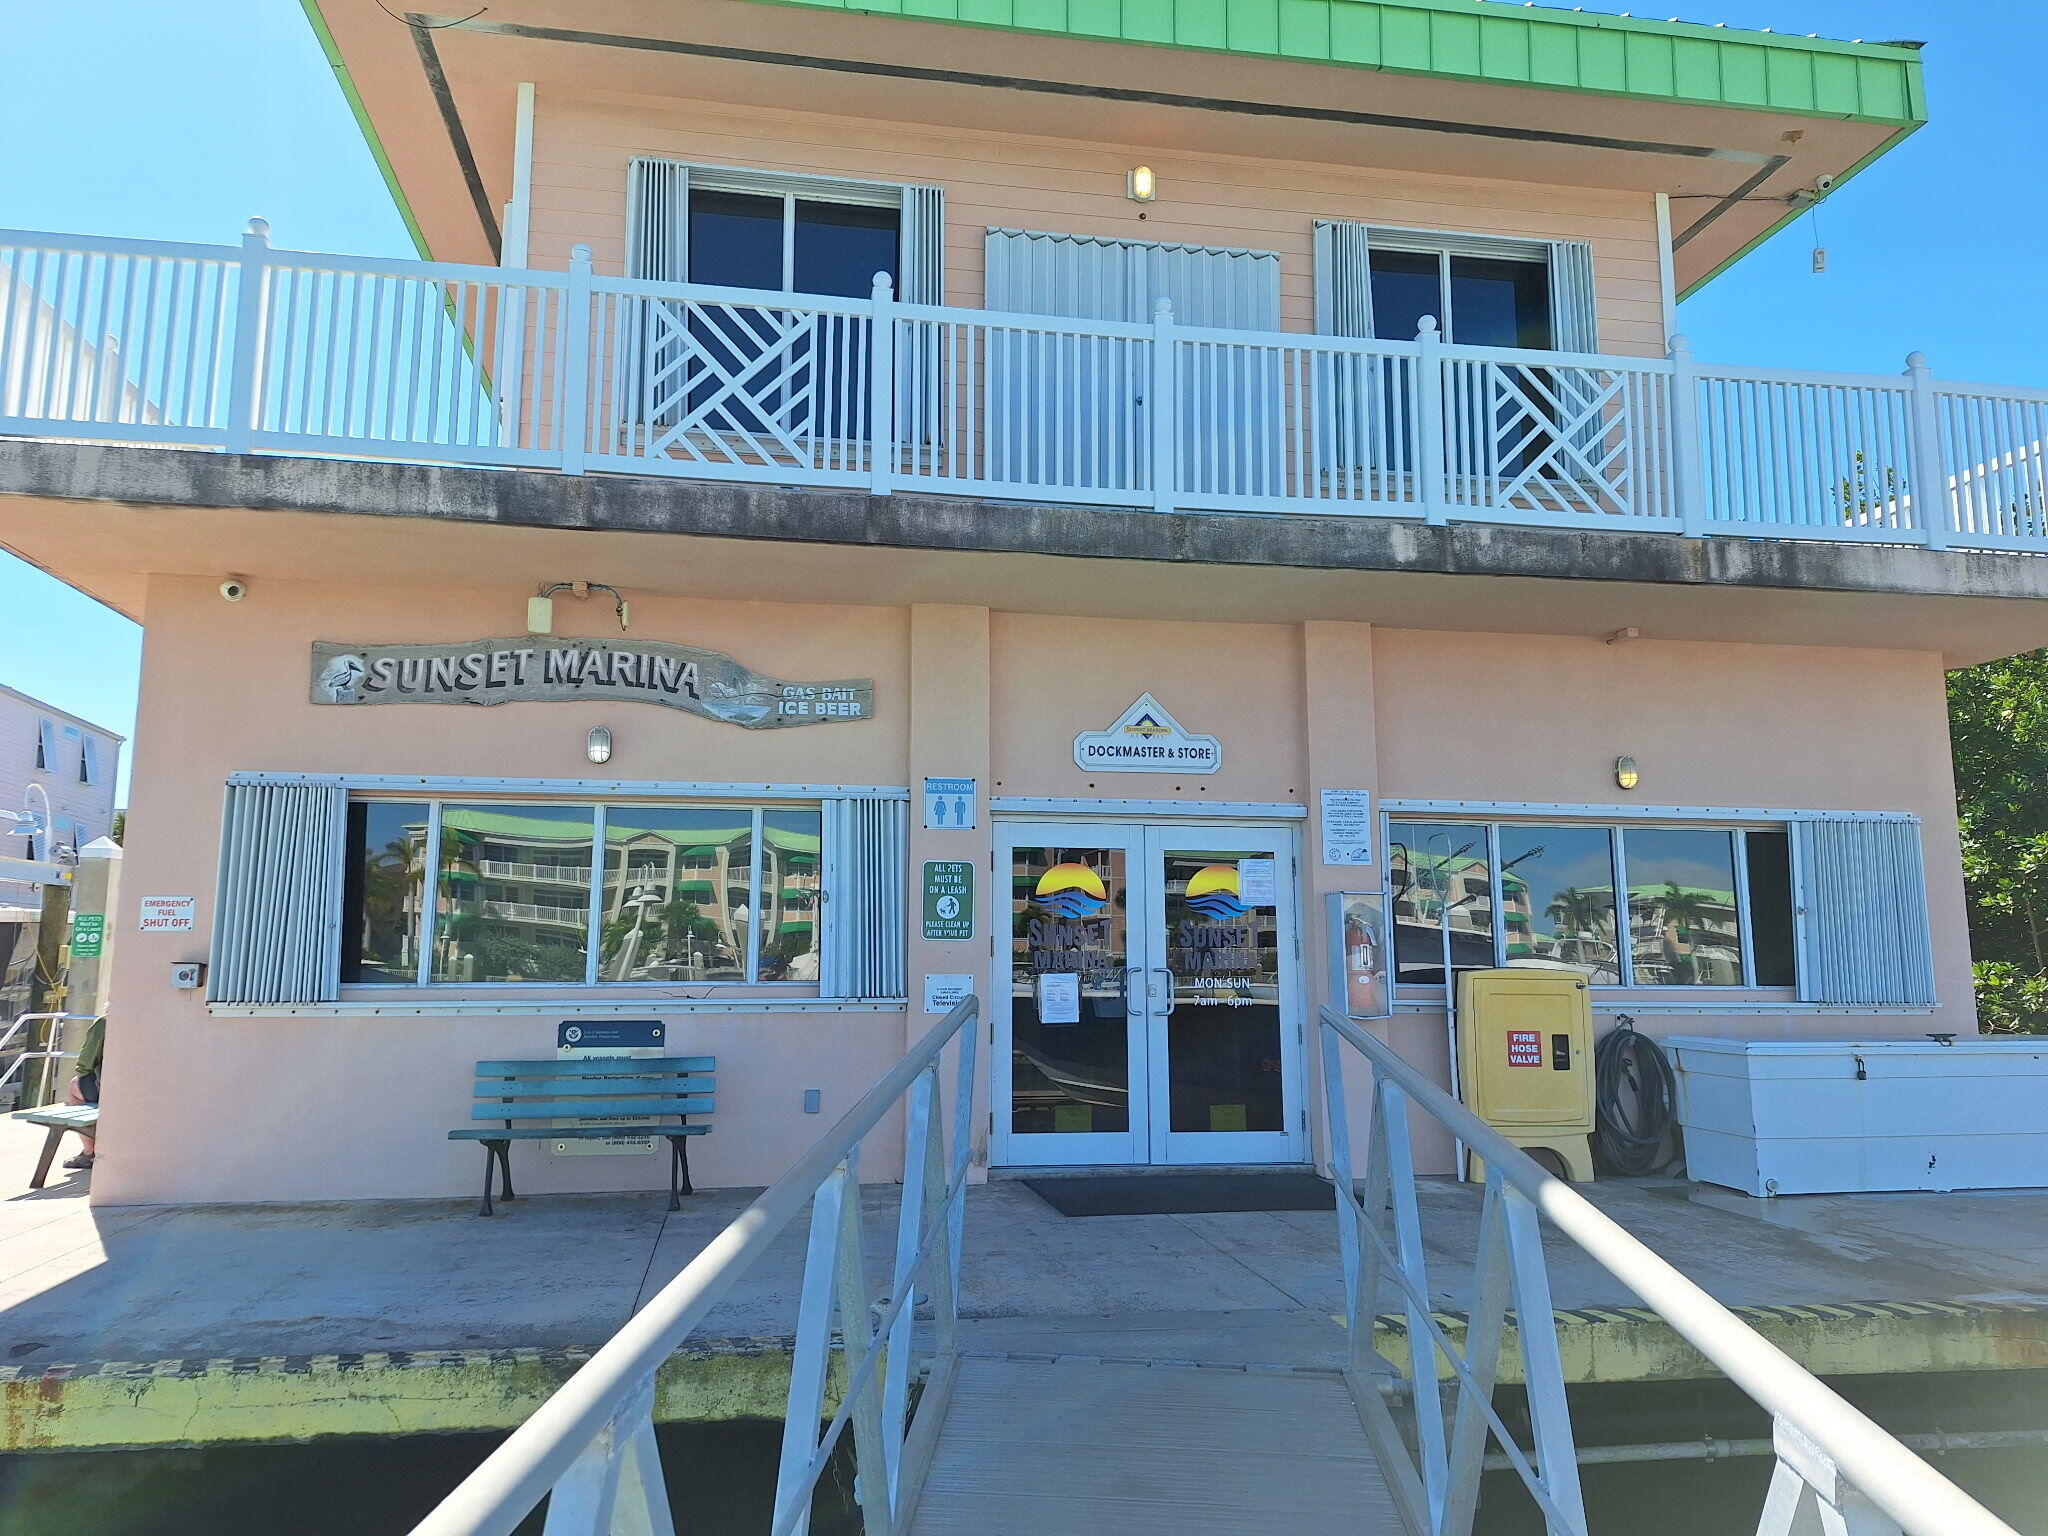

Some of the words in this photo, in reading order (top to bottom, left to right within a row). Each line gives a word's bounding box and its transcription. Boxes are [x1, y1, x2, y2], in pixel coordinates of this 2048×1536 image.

[362, 649, 533, 693] SUNSET
[544, 649, 700, 700] MARINA
[783, 687, 816, 700] GAS
[822, 687, 856, 700] BAIT
[779, 701, 809, 715] ICE
[815, 702, 861, 716] BEER
[1088, 745, 1165, 758] DOCKMASTER
[1169, 748, 1175, 758] &
[1178, 748, 1211, 759] STORE
[927, 783, 973, 791] RESTROOM
[934, 864, 946, 872] ALL
[947, 864, 963, 873] PETS
[935, 875, 952, 883] MUST
[954, 875, 962, 883] BE
[929, 886, 939, 894] ON
[941, 886, 946, 894] A
[947, 886, 967, 894] LEASH
[143, 918, 169, 927] SHUT
[172, 918, 191, 927] OFF
[1029, 918, 1113, 947] SUNSET
[1180, 920, 1261, 948] SUNSET
[1034, 950, 1109, 969] MARINA
[1184, 951, 1257, 970] MARINA
[1193, 995, 1218, 1006] 7am
[1227, 995, 1253, 1008] 6pm
[1512, 1034, 1536, 1042] FIRE
[1511, 1044, 1539, 1053] HOSE
[1510, 1055, 1540, 1064] VALVE
